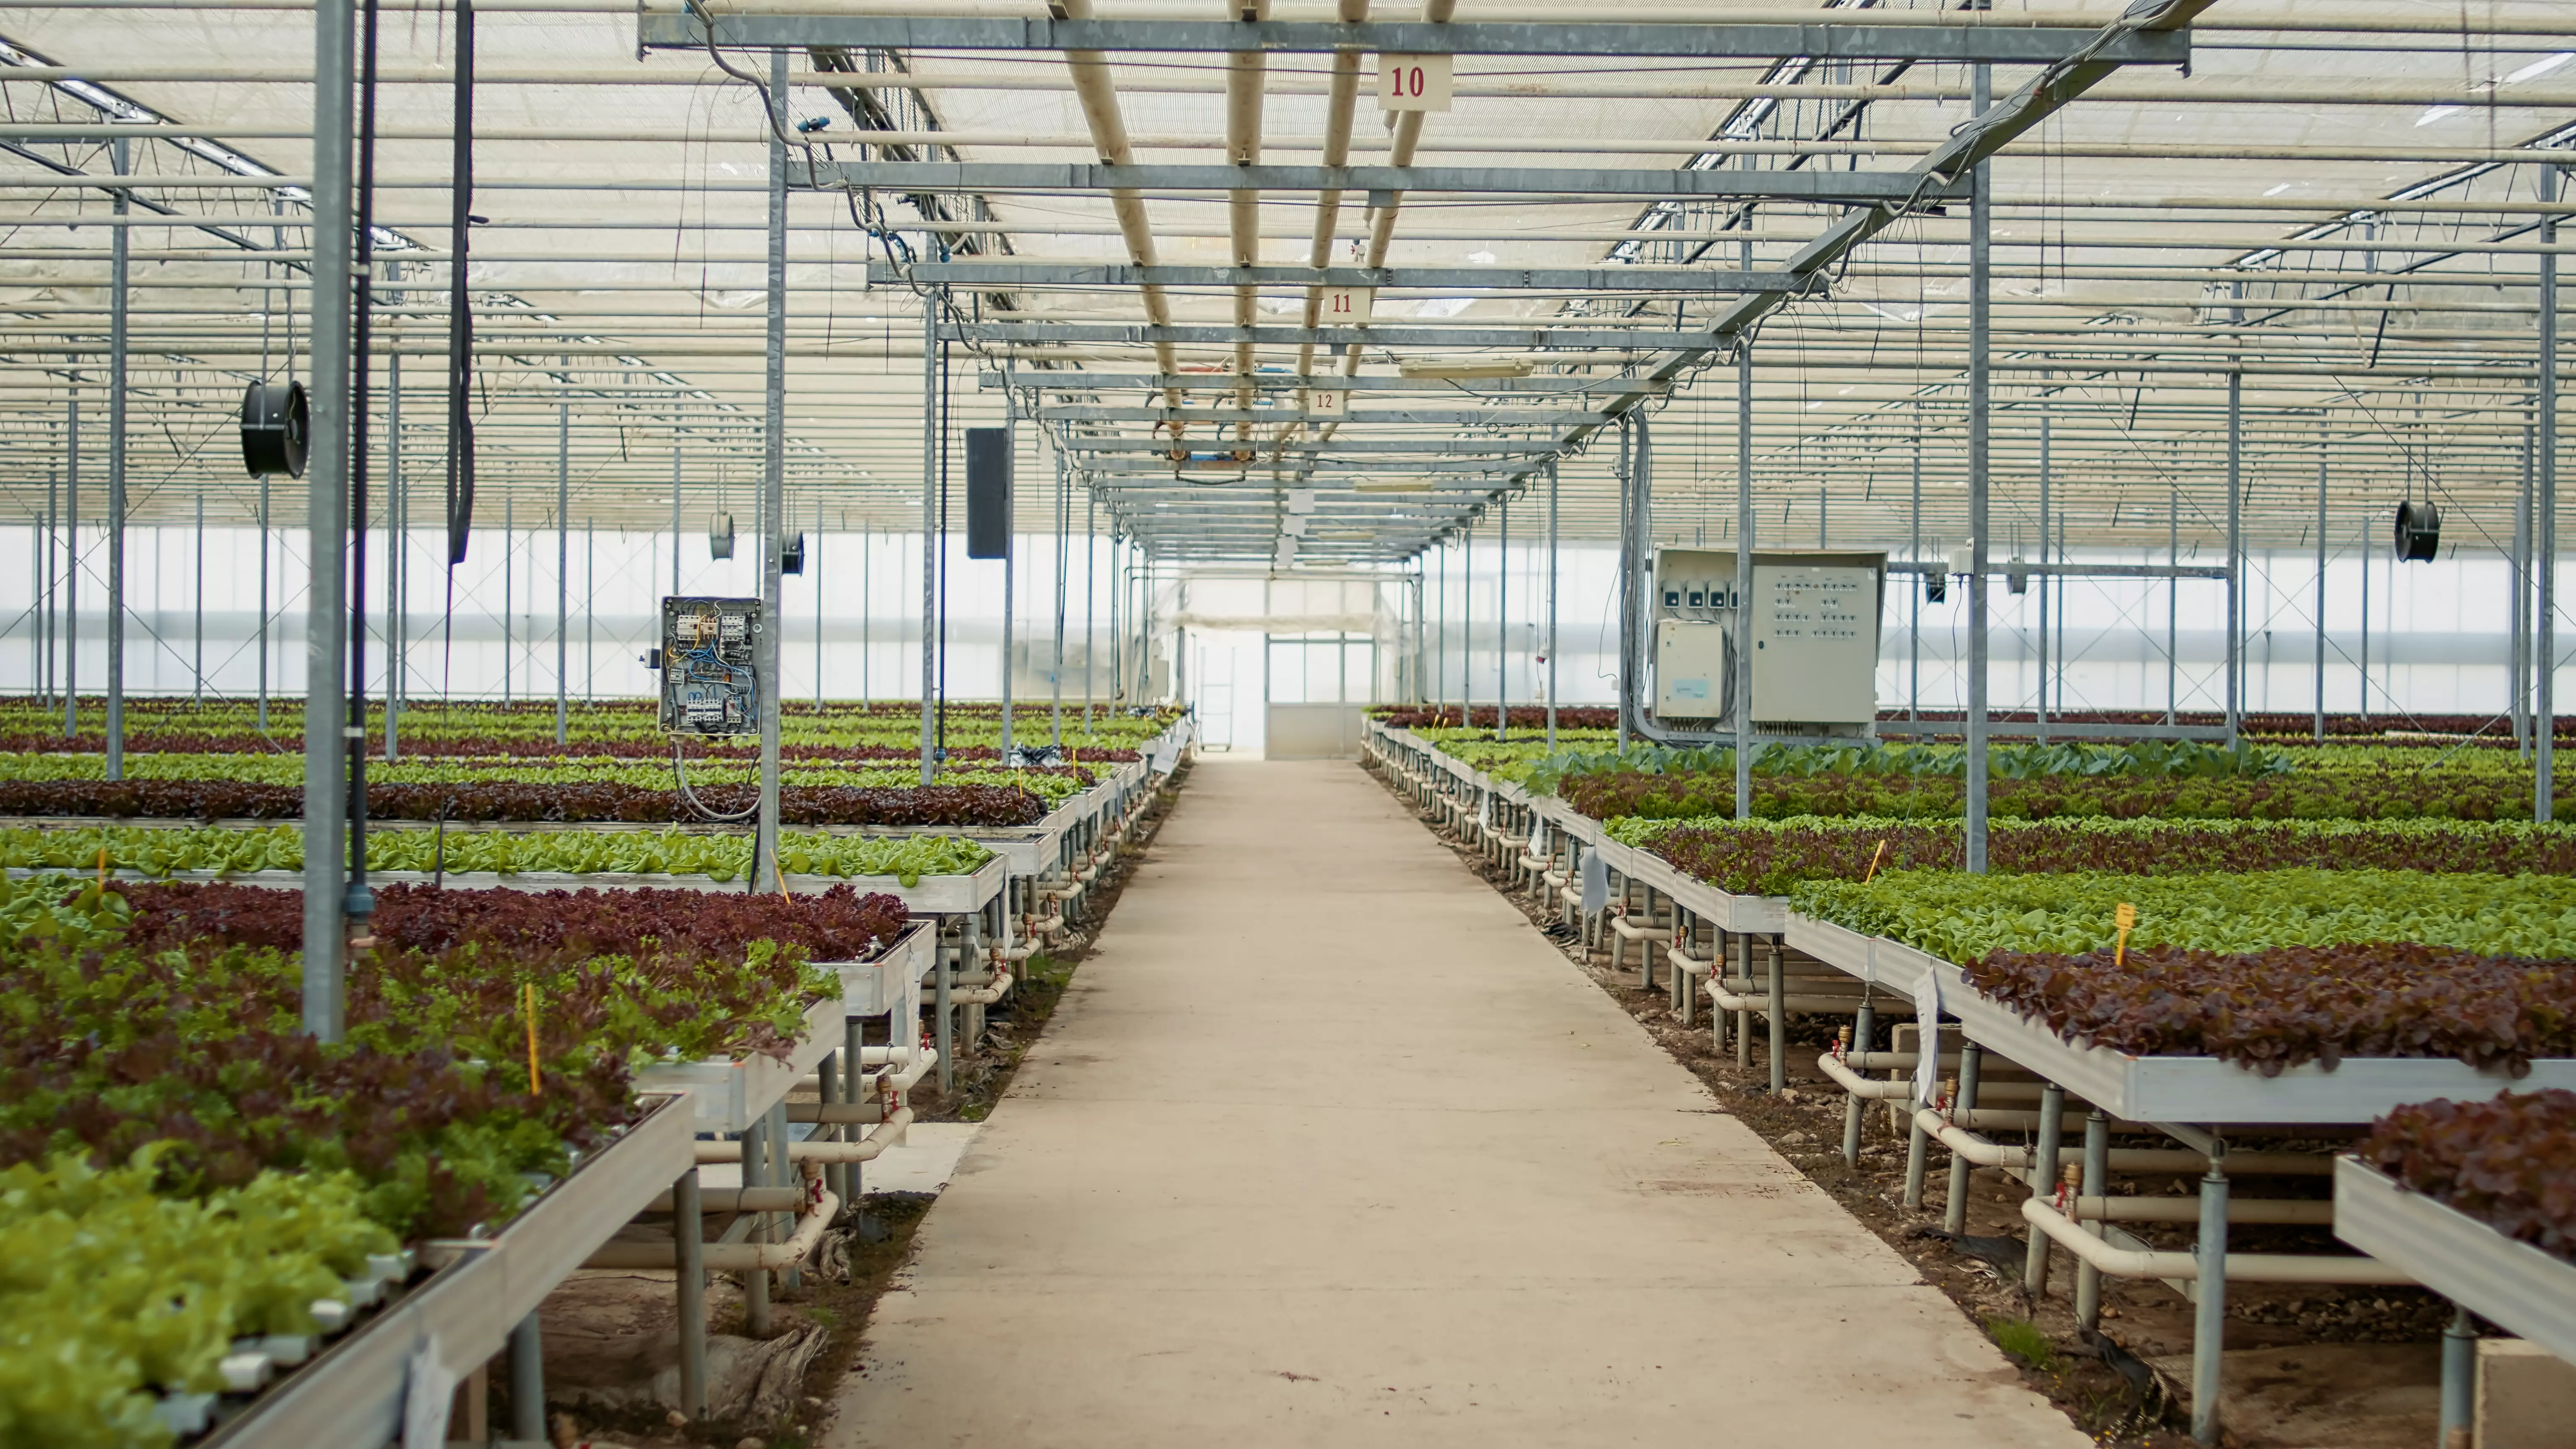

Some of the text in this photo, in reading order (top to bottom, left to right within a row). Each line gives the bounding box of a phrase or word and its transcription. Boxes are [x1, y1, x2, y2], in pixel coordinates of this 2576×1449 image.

[1392, 66, 1425, 98] 10
[1333, 294, 1351, 313] 11
[1317, 394, 1332, 408] 12
